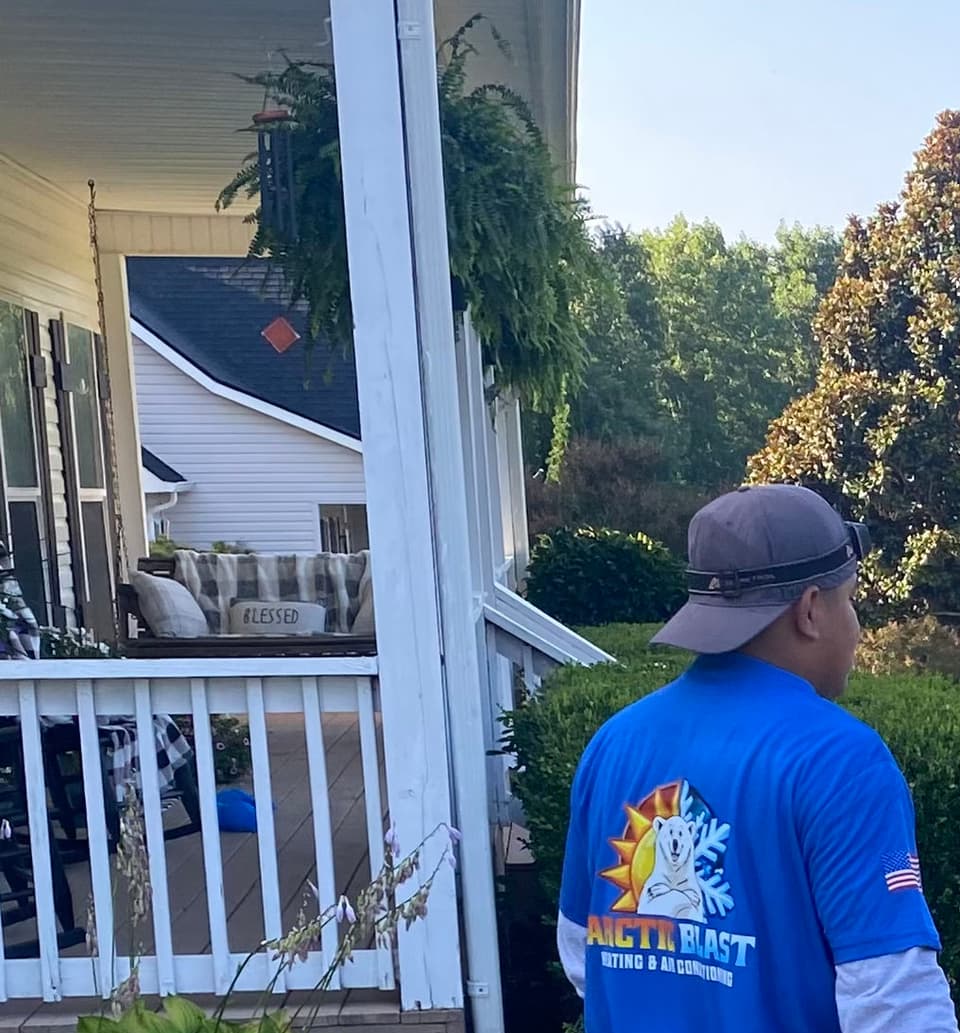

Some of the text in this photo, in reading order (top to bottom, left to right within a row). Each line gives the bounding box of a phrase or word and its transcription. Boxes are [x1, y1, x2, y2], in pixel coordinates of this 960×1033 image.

[243, 608, 299, 624] BLESSED
[678, 923, 756, 967] BLAST
[648, 955, 657, 970] &
